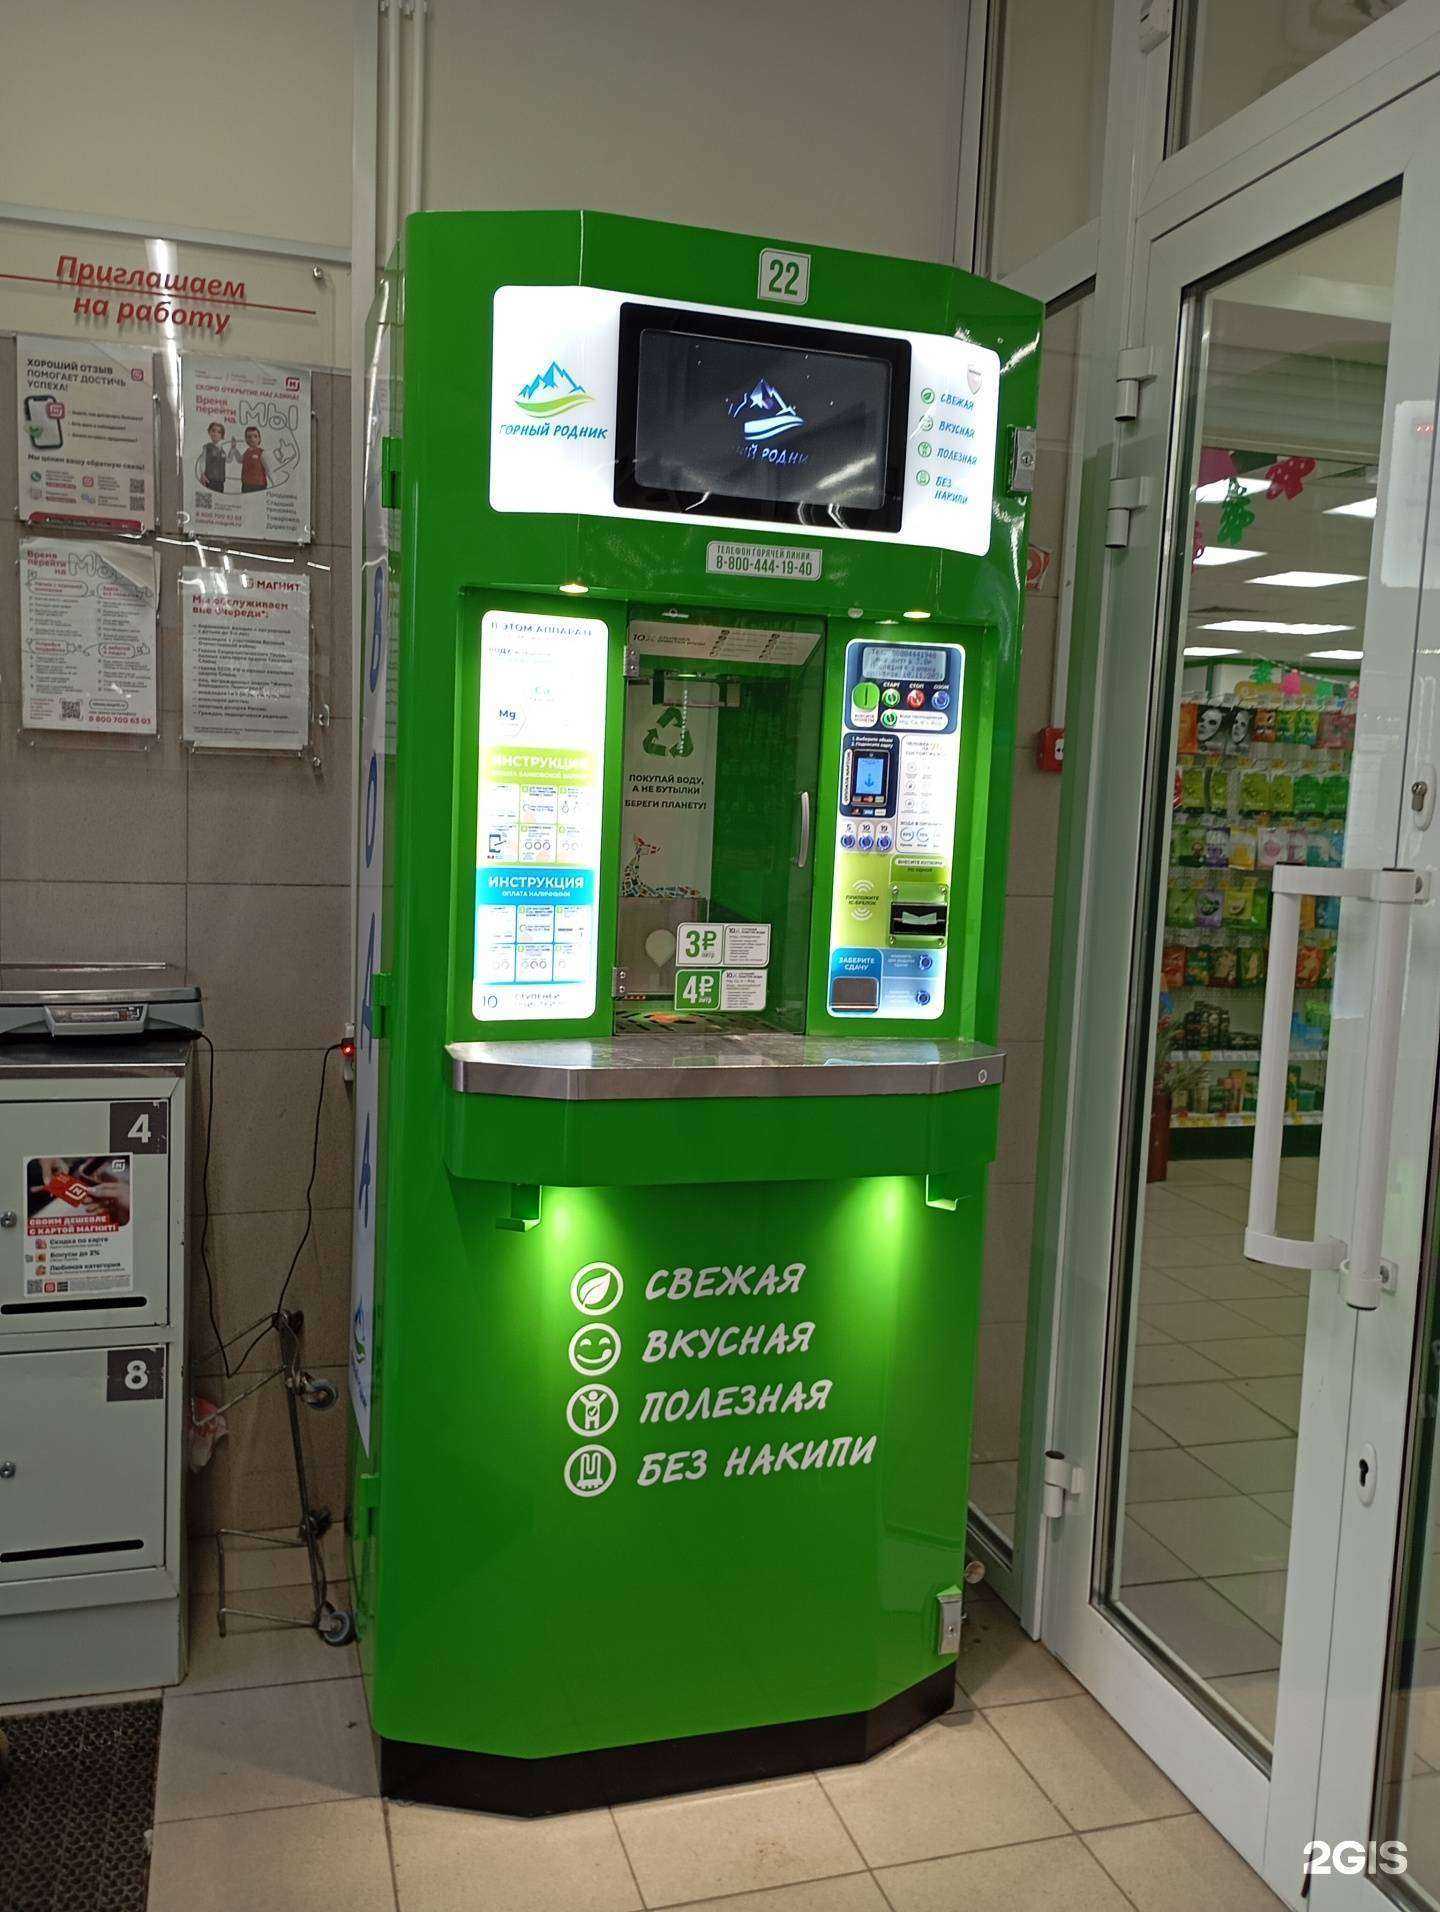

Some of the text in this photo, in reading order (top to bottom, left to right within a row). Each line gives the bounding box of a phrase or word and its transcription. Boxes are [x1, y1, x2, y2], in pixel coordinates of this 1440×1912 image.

[56, 255, 247, 300] Приглашаем
[769, 258, 800, 296] 22
[73, 297, 232, 334] на работу
[27, 358, 113, 375] ХОРОШИЙ ОТЗЫВ
[27, 369, 127, 387] ПОМОГАЕТ ДОСТИЧЬ
[27, 380, 69, 392] УСПЕХА!
[940, 393, 975, 411] СВЕЖАЯ
[499, 421, 609, 440] ГОРНЫЙ РОДНИК
[938, 421, 975, 439] ВКУСНАЯ
[937, 447, 978, 465] ПОЛЕЗНАЯ
[935, 475, 952, 488] БЕЗ
[934, 489, 969, 505] НАКИПИ
[717, 545, 751, 556] ТЕЛЕФОН
[752, 548, 785, 559] ГОРЯЧЕЙ
[716, 555, 812, 576] 8-800-444-19-40
[256, 580, 301, 592] МАГНИТ
[499, 709, 517, 720] Mg
[629, 774, 704, 786] ПОКУПАЙ ВОДУ,
[632, 785, 700, 794] А НЕ БУТЫЛКИ
[624, 800, 707, 810] БЕРЕГИ ПЛАНЕТУ!
[488, 876, 584, 890] ИНСТРУКЦИЯ
[127, 1113, 152, 1144] 4
[37, 1226, 75, 1235] КАРТОЙ
[644, 1262, 807, 1302] СВЕЖАЯ
[641, 1320, 817, 1364] ВКУСНАЯ
[124, 1359, 149, 1390] 8
[639, 1378, 834, 1424] ПОЛЕЗНАЯ
[636, 1434, 879, 1488] БЕЗ НАКИПИ
